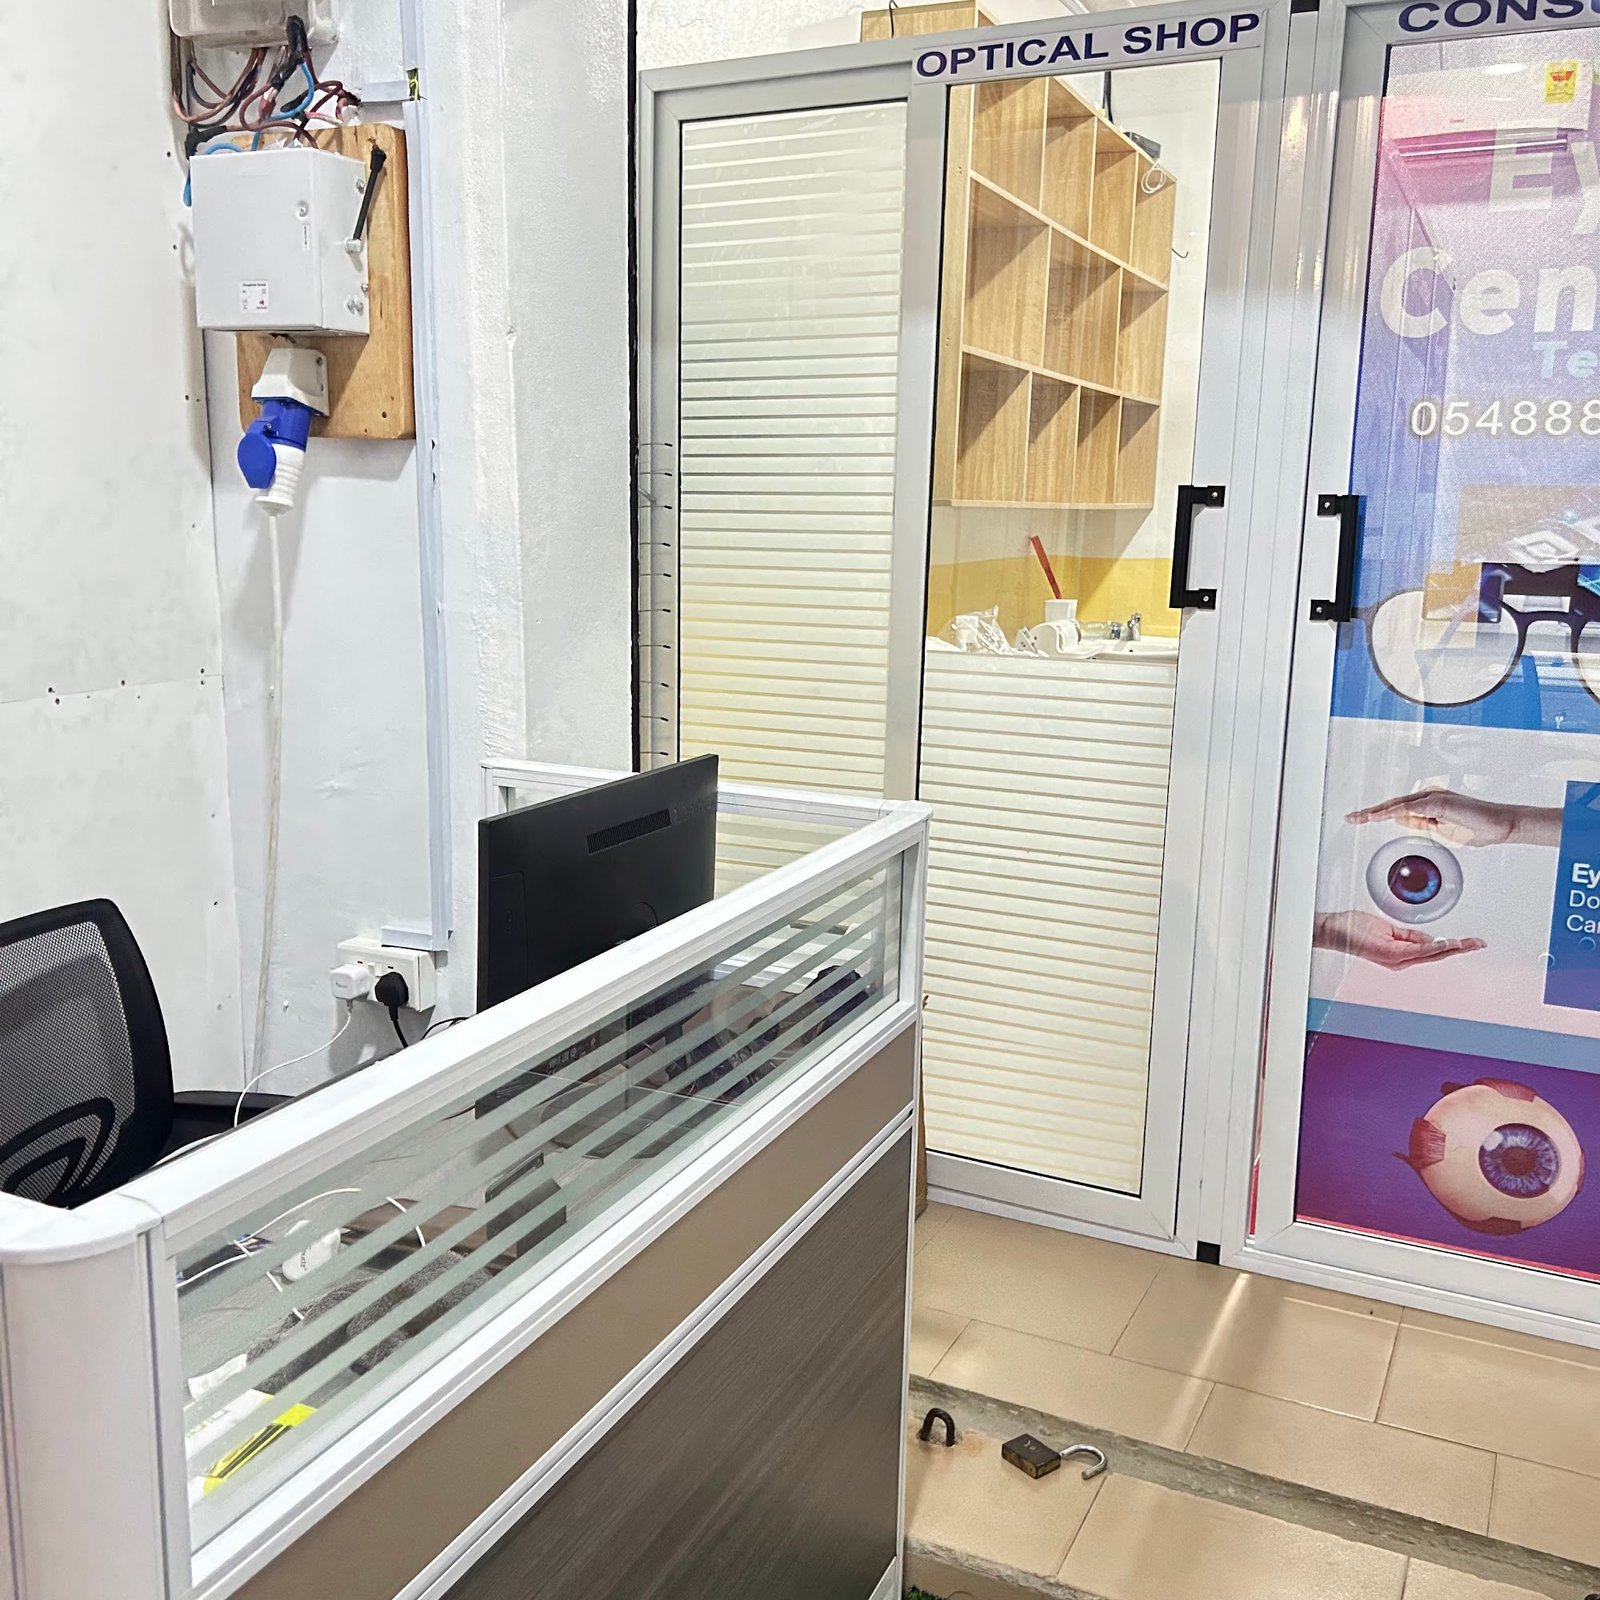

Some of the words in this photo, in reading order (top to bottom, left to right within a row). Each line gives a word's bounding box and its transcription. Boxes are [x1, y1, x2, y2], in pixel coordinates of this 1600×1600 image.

[1399, 0, 1600, 32] CONS
[916, 33, 1109, 78] OPTICAL
[1123, 13, 1260, 55] SHOP
[1380, 246, 1599, 338] Cen
[1533, 340, 1599, 379] Te
[1411, 399, 1600, 436] 054888
[1569, 889, 1600, 909] Do
[1565, 914, 1600, 934] Ca
